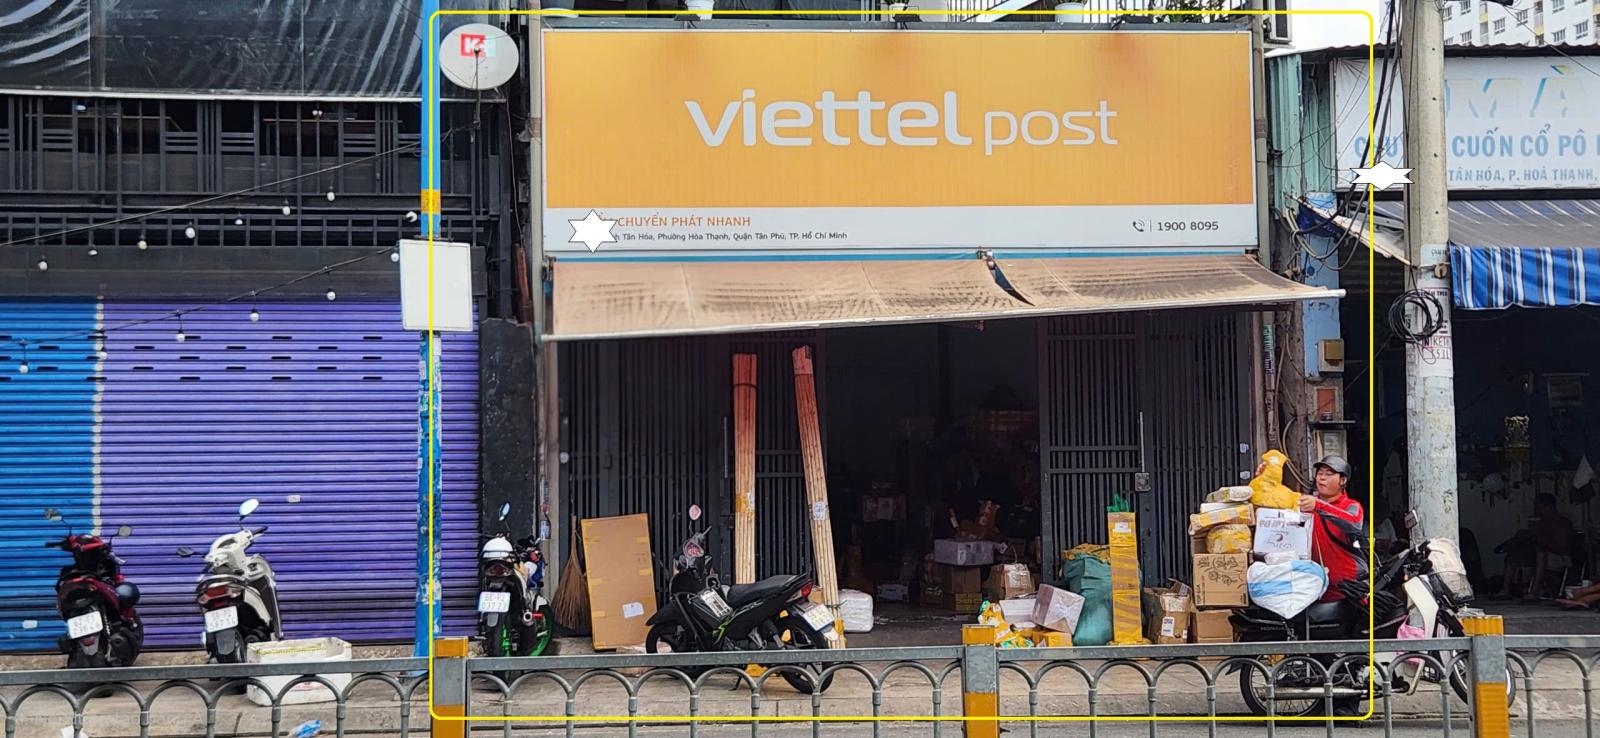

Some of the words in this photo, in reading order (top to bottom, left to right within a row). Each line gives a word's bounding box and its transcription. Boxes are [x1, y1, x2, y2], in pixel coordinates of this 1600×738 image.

[684, 89, 973, 147] viettel
[984, 100, 1118, 156] post
[1451, 126, 1513, 158] CUỐN
[1520, 123, 1551, 157] CỔ
[1558, 128, 1587, 157] PÔ
[1448, 166, 1473, 182] TÂN
[671, 214, 704, 227] PHÁT
[707, 216, 751, 227] NHANH
[1157, 221, 1186, 231] 1900
[1190, 221, 1219, 231] 8095
[829, 231, 848, 239] Minh
